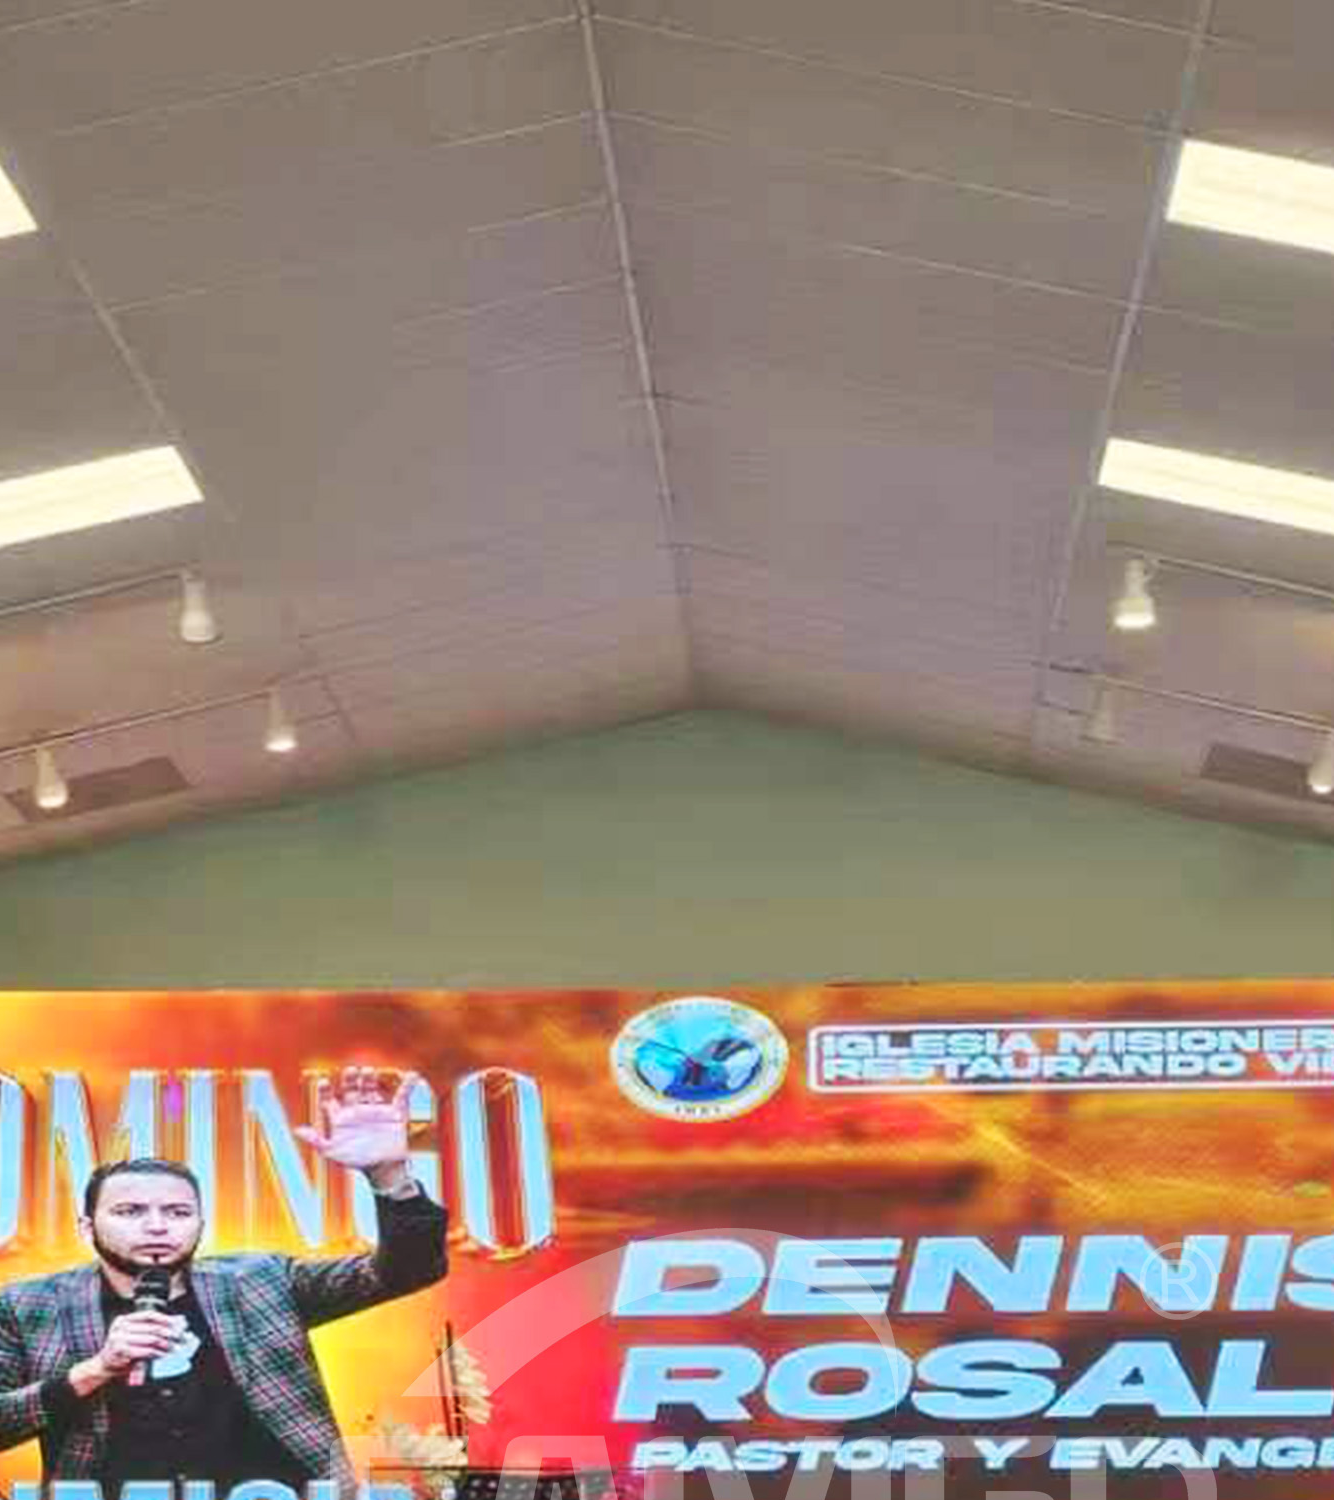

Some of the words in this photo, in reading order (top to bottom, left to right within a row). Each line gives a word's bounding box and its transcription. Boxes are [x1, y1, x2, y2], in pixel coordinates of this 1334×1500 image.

[822, 1031, 1034, 1057] IGLESIA
[822, 1052, 1247, 1080] RESTAURANDO
[629, 1439, 946, 1474] PASTOR
[977, 1438, 1031, 1471] Y
